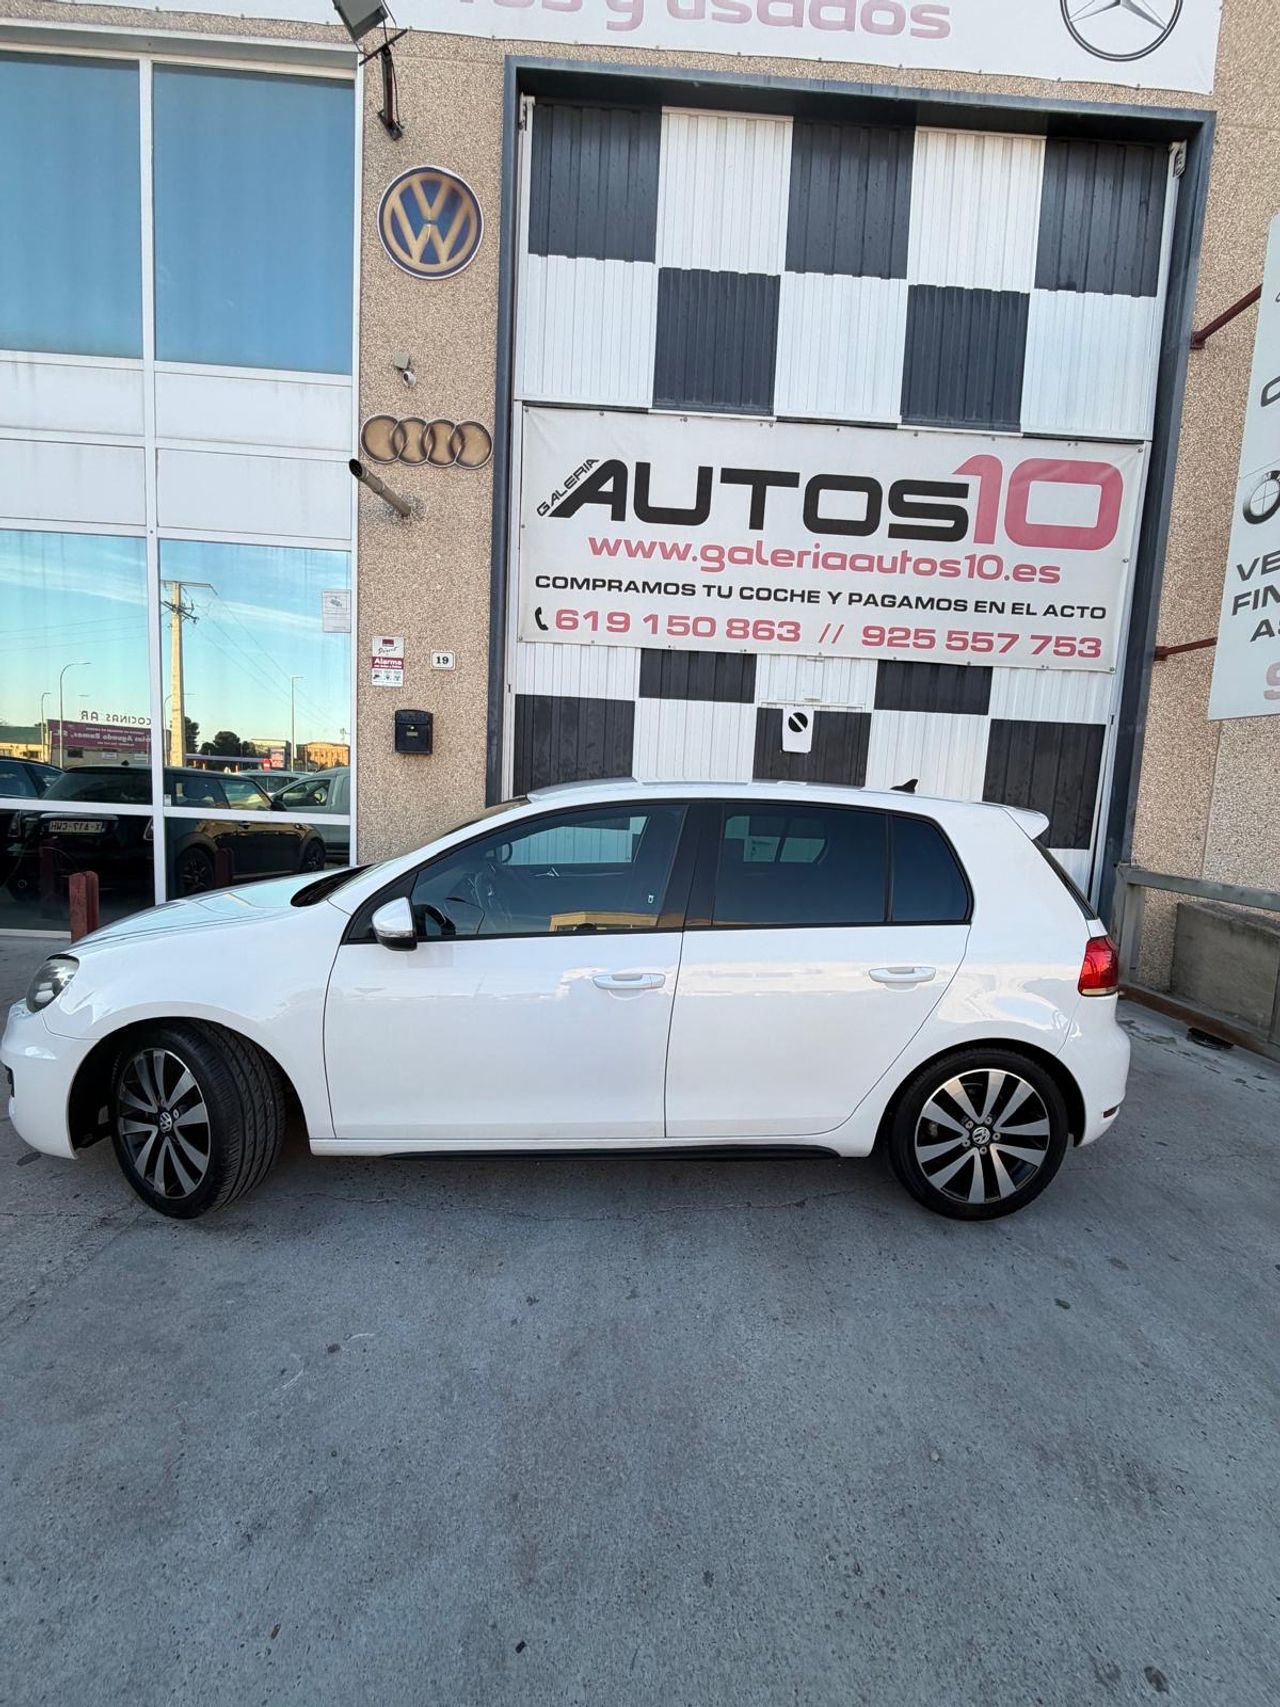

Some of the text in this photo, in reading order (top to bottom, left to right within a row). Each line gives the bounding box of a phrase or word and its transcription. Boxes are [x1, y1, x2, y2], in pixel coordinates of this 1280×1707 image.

[666, 0, 951, 39] usados
[536, 458, 600, 518] GALERIA
[587, 536, 1062, 584] www.galeriaautos10.es
[535, 575, 1107, 620] COMPRAMOS TU COCHE Y PAGAMOS EN EL ACTO
[555, 608, 632, 633] 619
[642, 613, 717, 637] 150
[725, 619, 801, 642] 863
[861, 625, 937, 650] 925
[944, 631, 1020, 654] 557
[1029, 635, 1102, 659] 753
[1250, 618, 1280, 643] A
[374, 657, 402, 665] Alarma
[436, 656, 450, 665] 19
